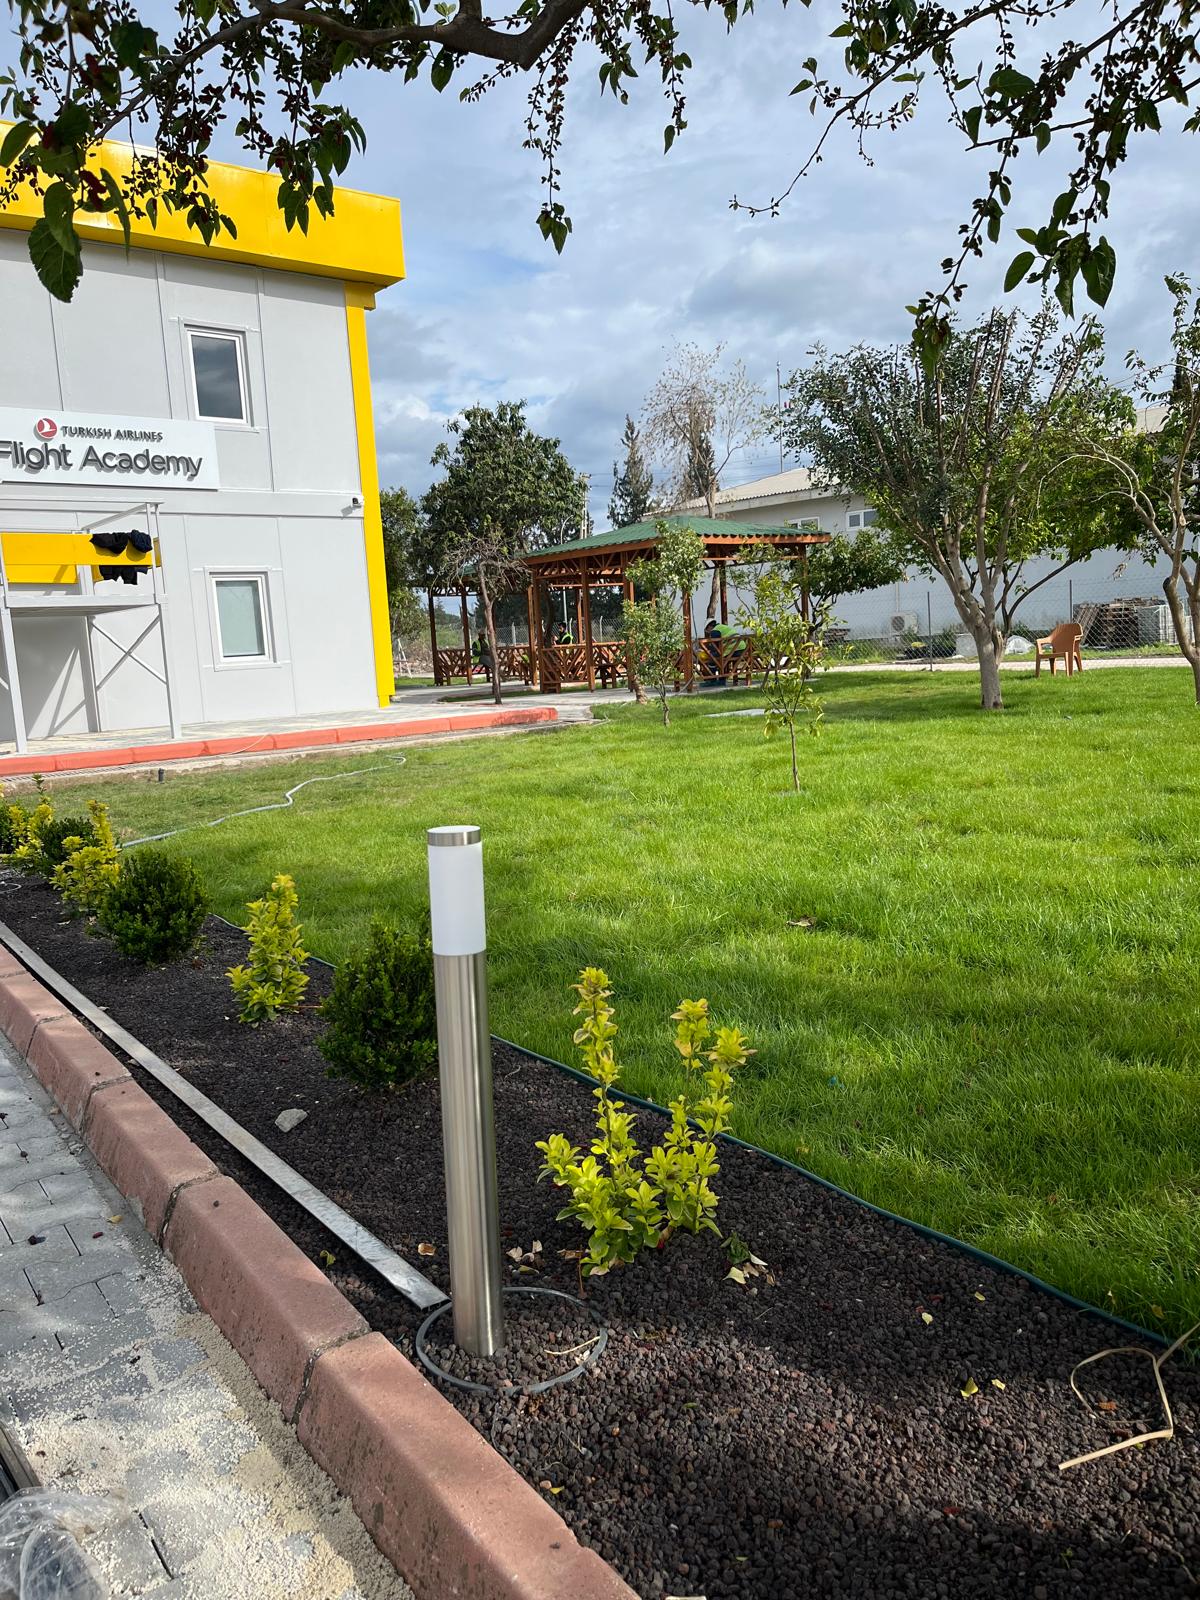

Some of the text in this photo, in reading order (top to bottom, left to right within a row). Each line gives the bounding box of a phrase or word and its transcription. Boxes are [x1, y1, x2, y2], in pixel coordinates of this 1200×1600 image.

[62, 426, 163, 442] TURKISH AIRLINES
[82, 445, 203, 478] Academy
